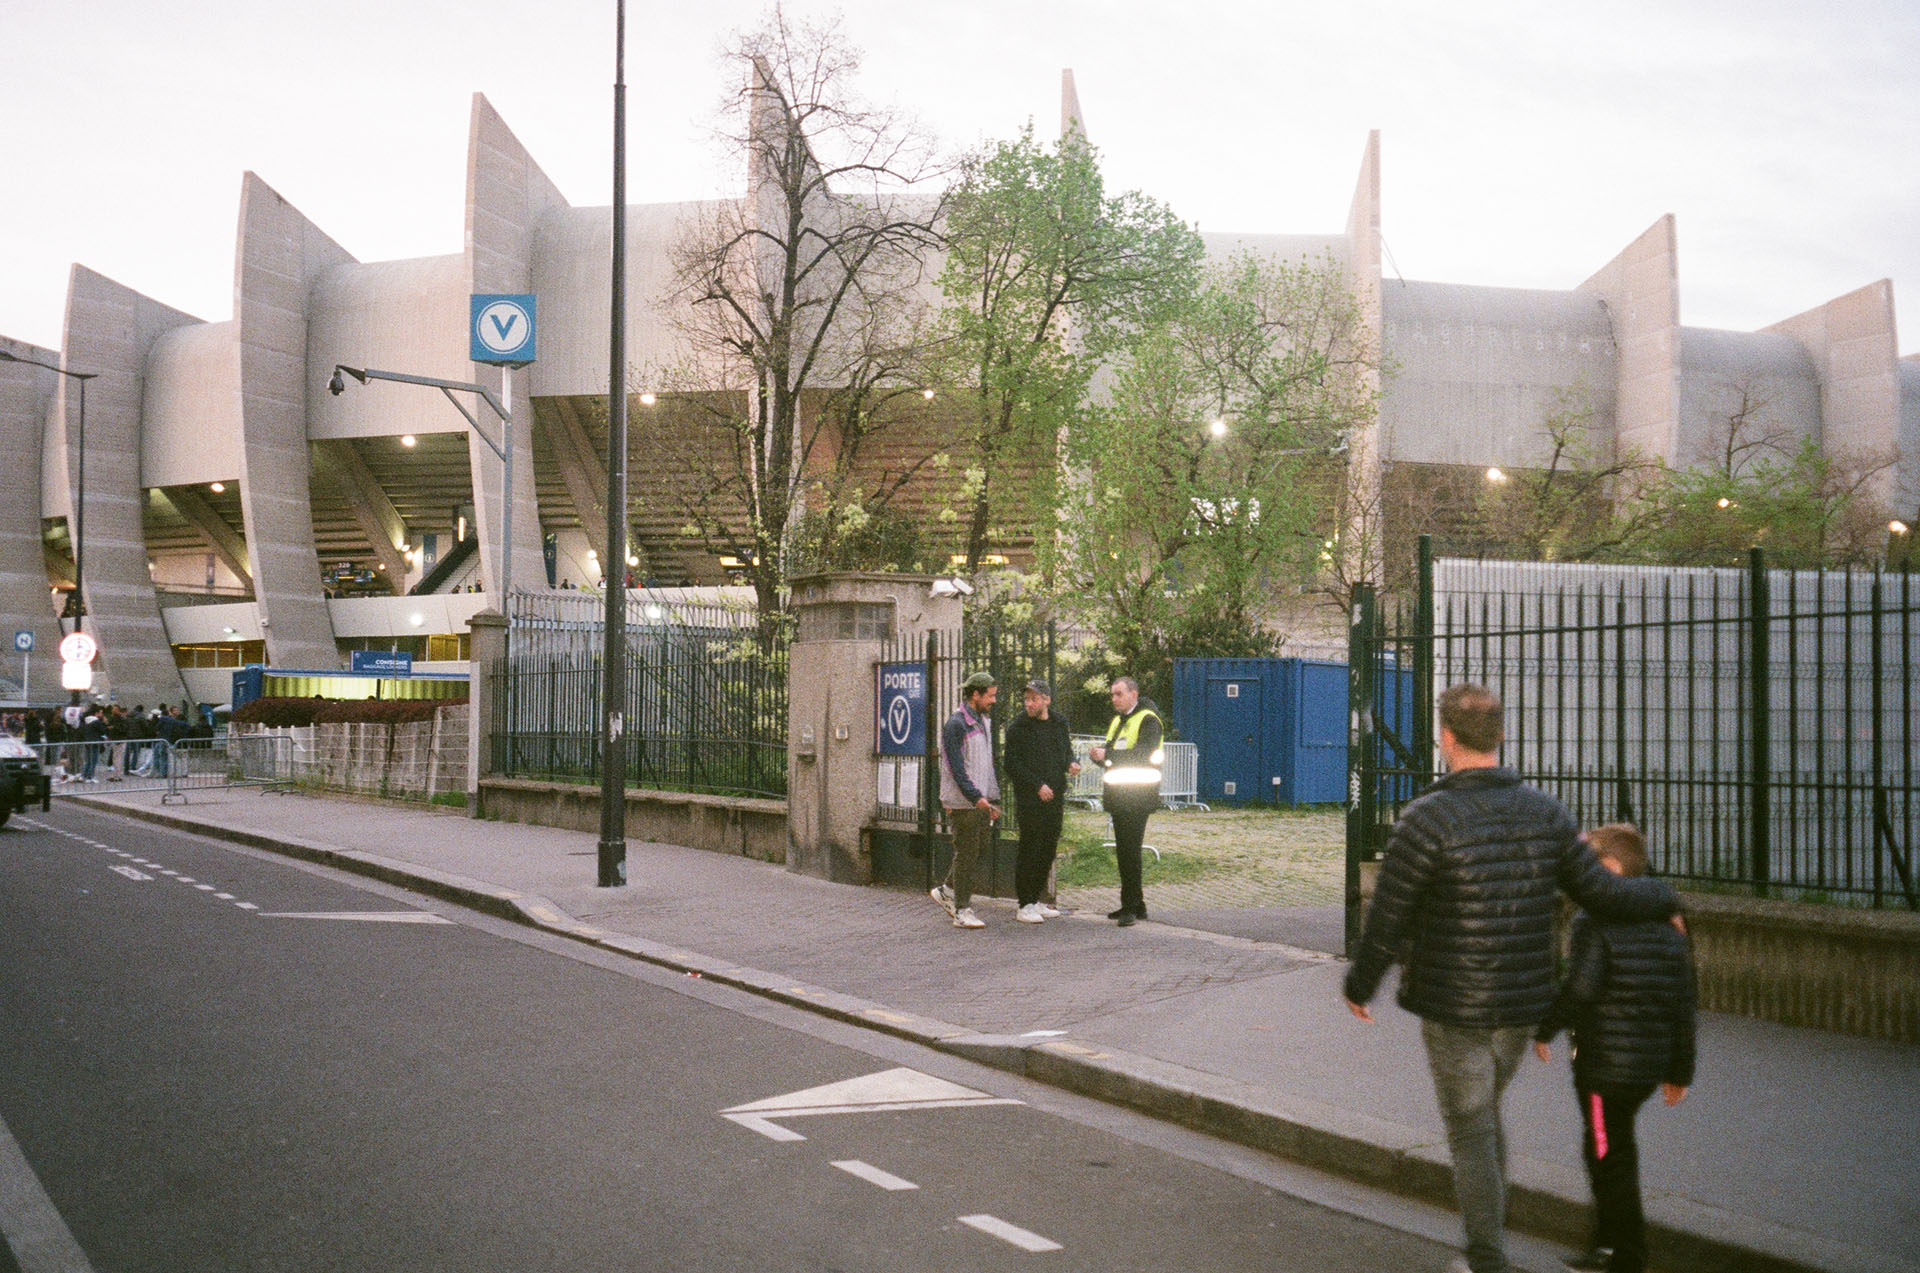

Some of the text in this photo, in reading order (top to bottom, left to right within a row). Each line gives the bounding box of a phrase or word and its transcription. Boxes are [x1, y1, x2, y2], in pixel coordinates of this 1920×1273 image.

[490, 314, 518, 341] V
[884, 673, 921, 689] PORTE
[893, 709, 905, 734] V
